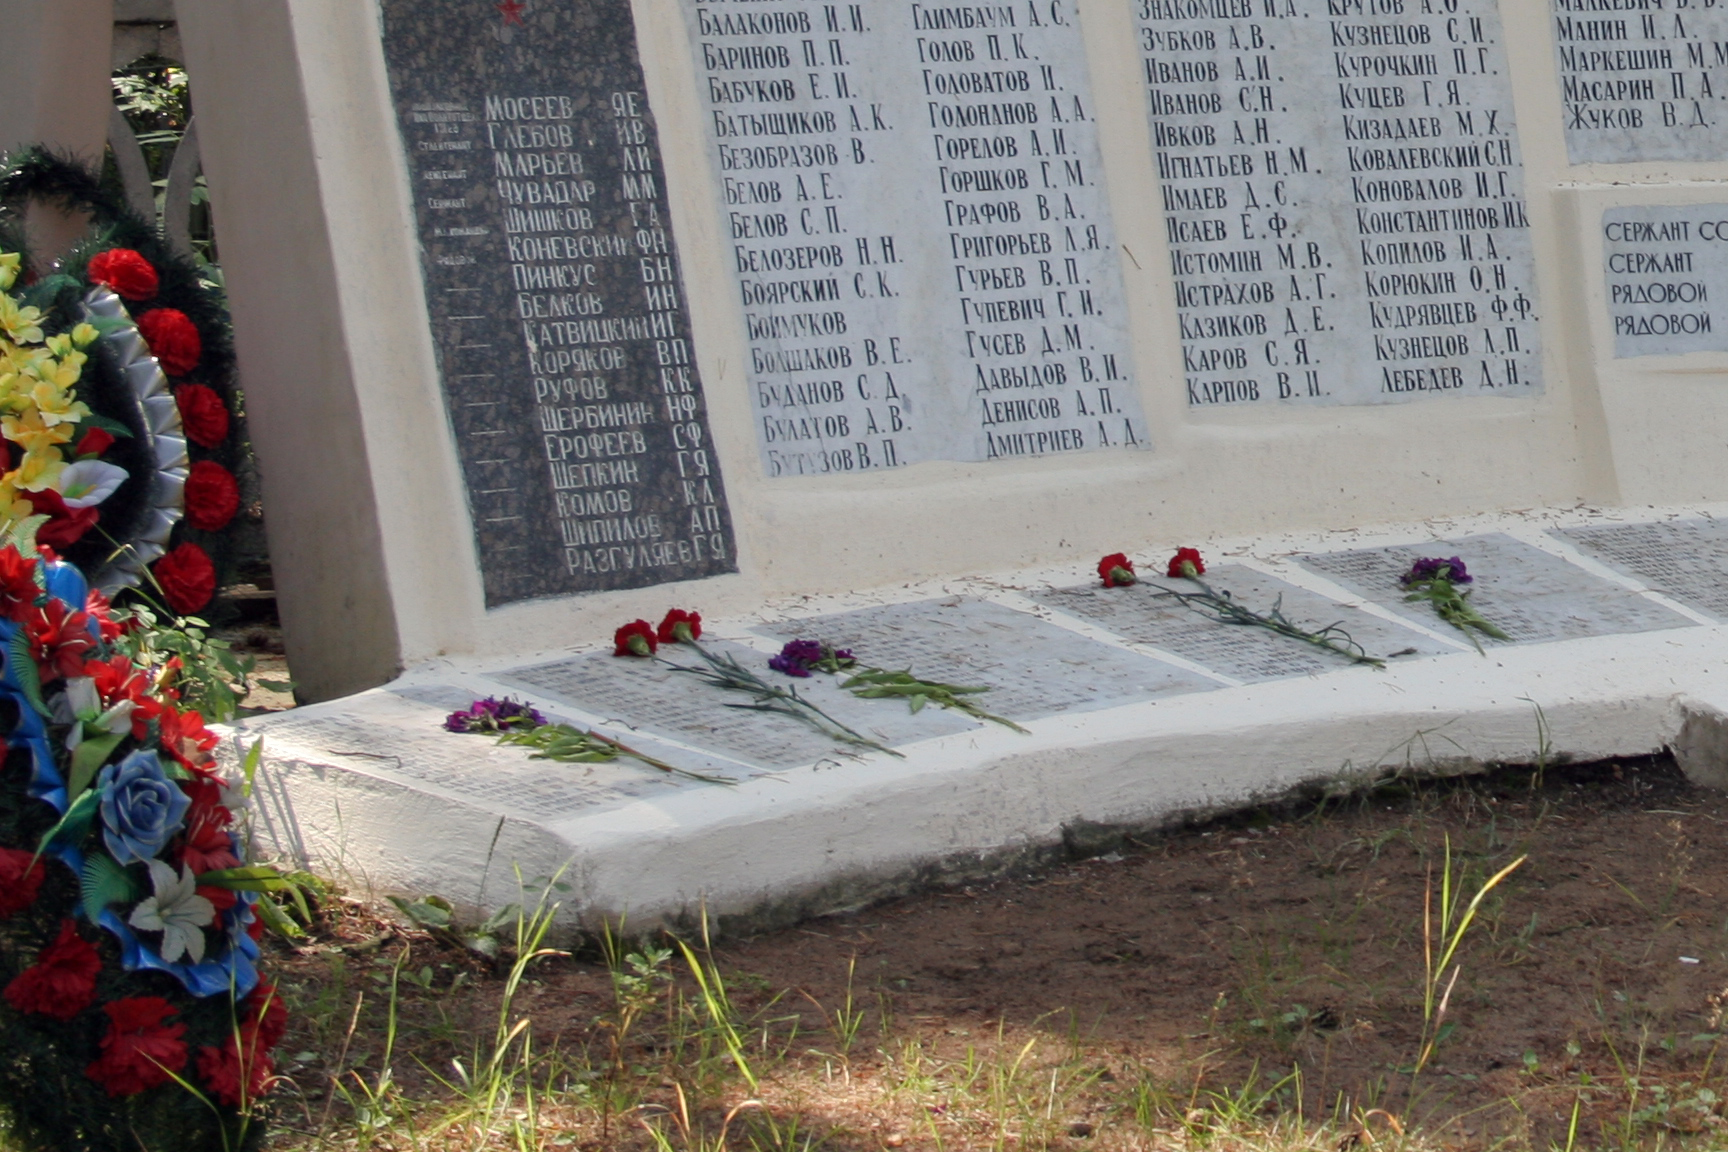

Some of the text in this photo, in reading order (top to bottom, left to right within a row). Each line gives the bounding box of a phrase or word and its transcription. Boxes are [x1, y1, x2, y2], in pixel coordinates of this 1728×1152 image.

[701, 43, 790, 70] БАРИНОВ
[485, 94, 573, 120] МОСЕЕВ
[488, 122, 573, 149] ГЛЕБОВ
[494, 151, 583, 177] МАРЬЕВ
[622, 174, 657, 200] ММ
[720, 177, 782, 204] БЕЛОВ
[1606, 221, 1690, 242] СЕРЖАНТ
[511, 258, 672, 290] ПИНКУС БН
[1609, 252, 1693, 273] СЕРЖАНТ
[517, 286, 677, 318] БЕЛКОВ ИН
[1612, 281, 1707, 303] РЯДОВОЙ
[1615, 312, 1711, 335] РЯДОВОЙ
[534, 376, 608, 403] РУФОВ
[545, 431, 647, 461] ЕРОФЕЕВ
[556, 489, 631, 517] КОМОВ
[565, 540, 693, 576] РАЗГУЛЯЕВ
